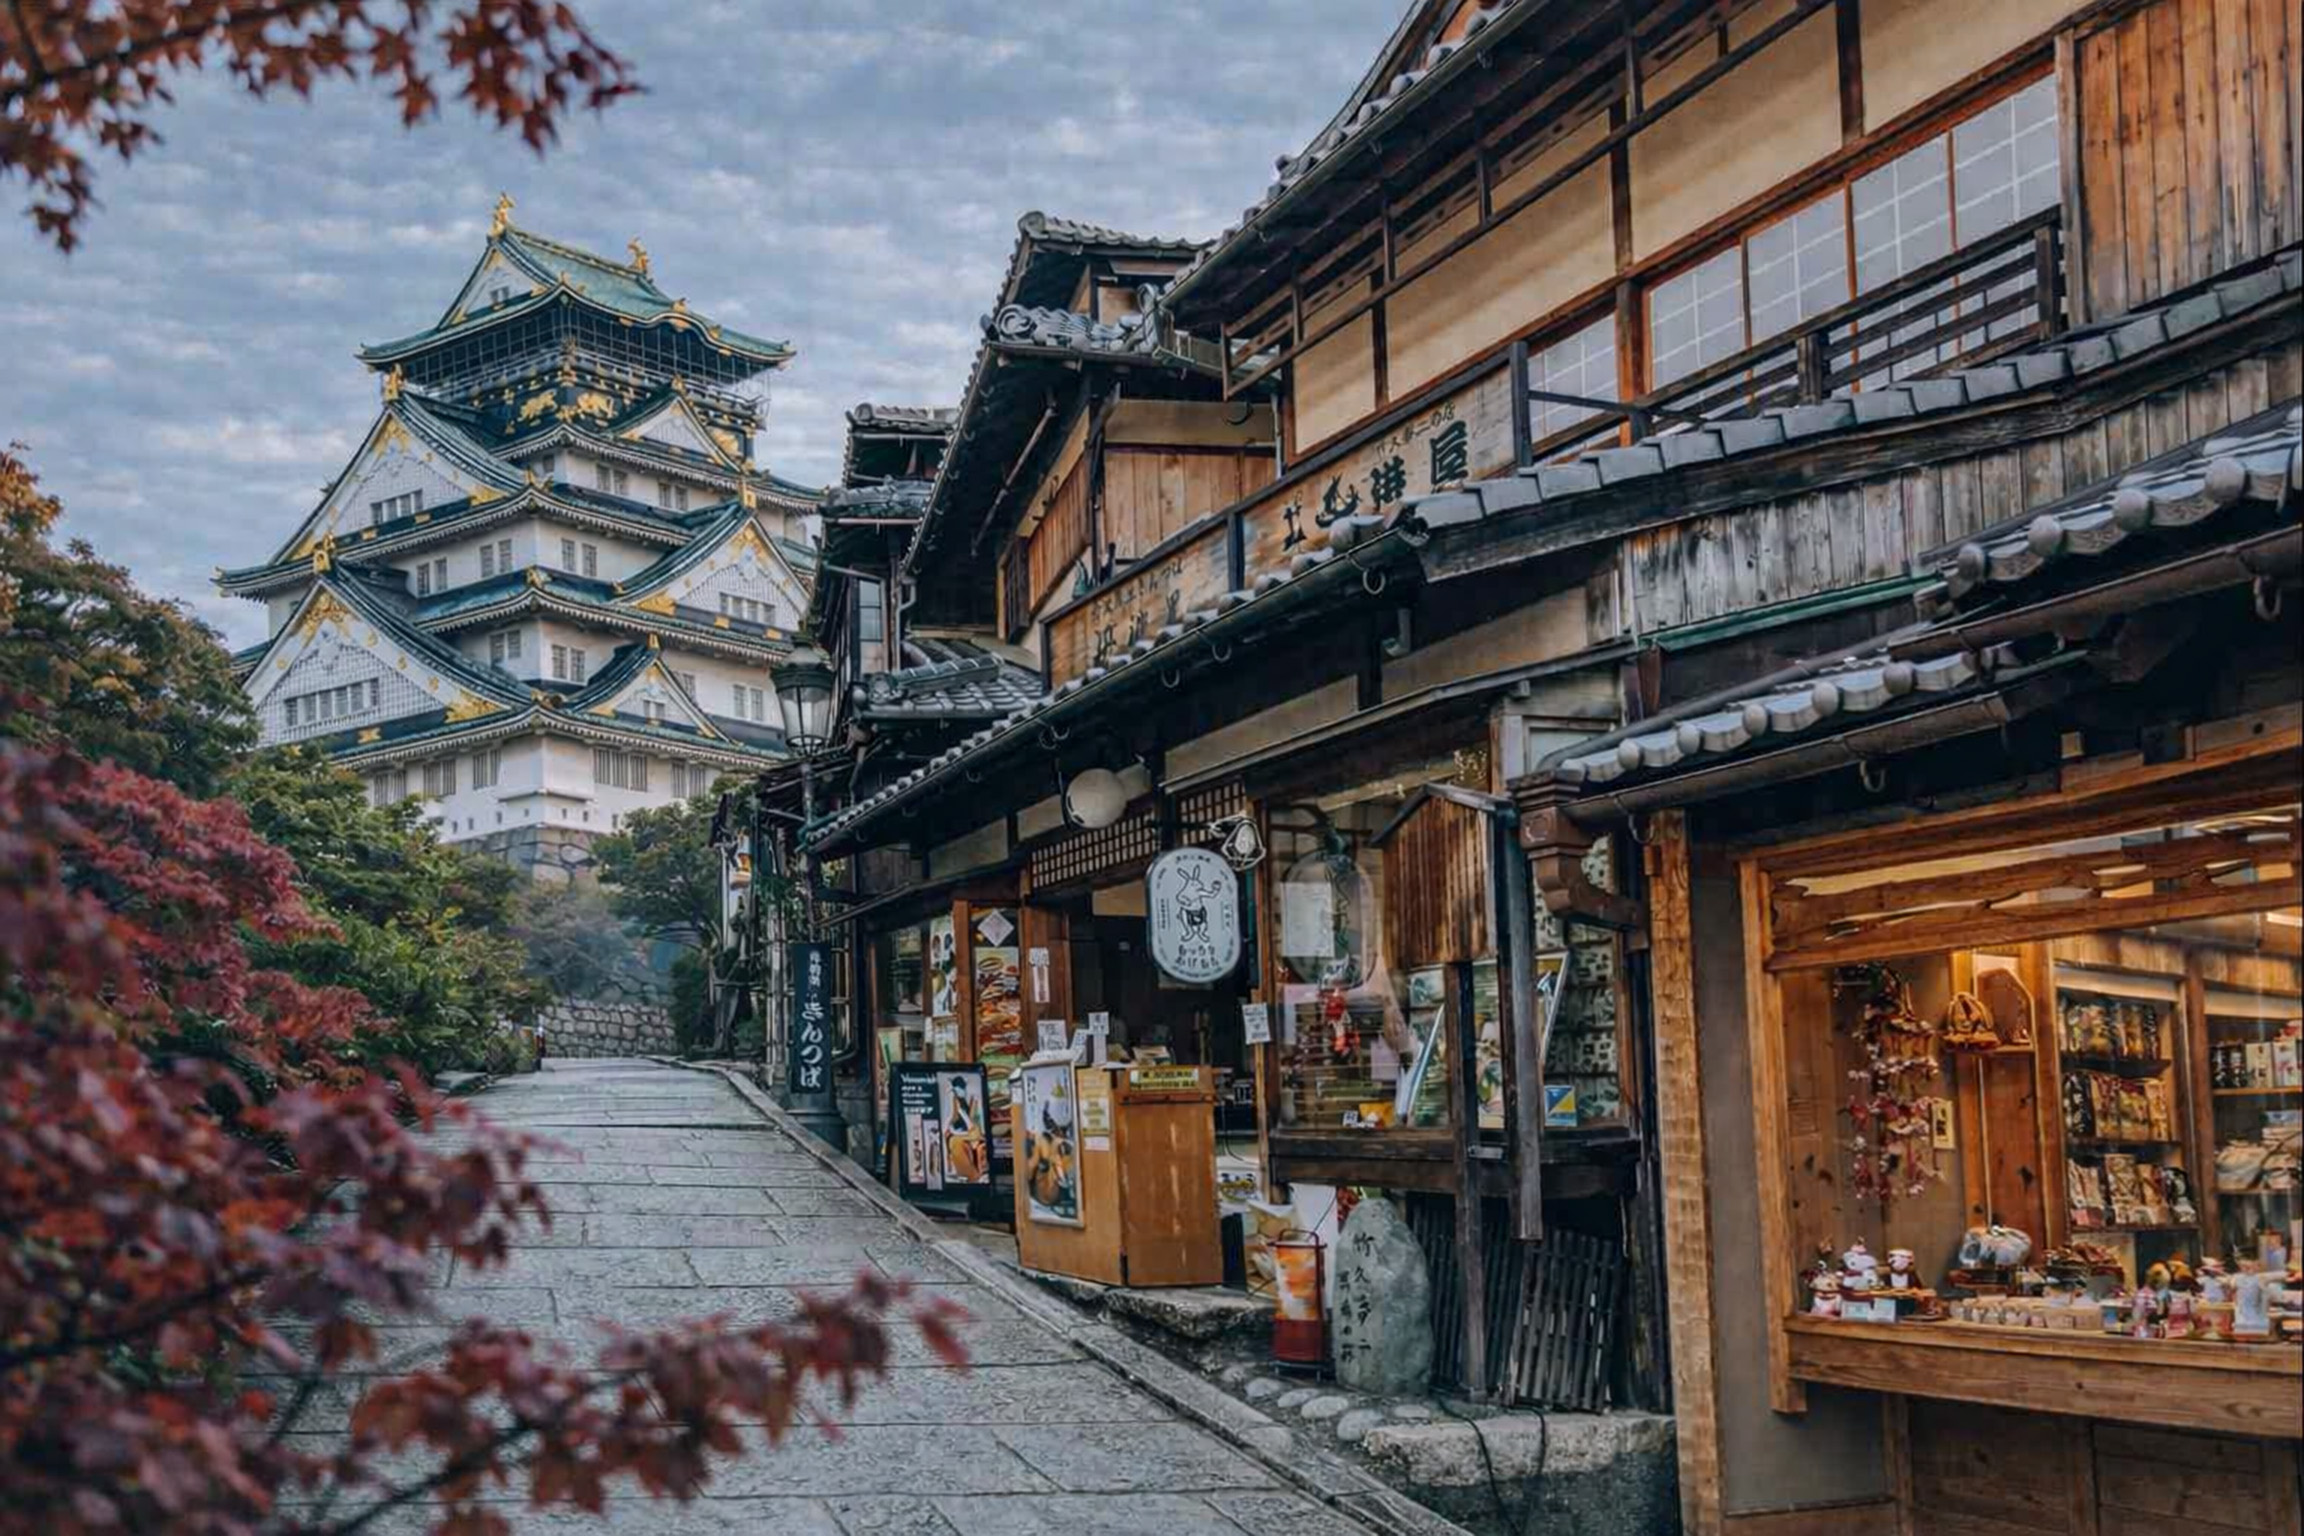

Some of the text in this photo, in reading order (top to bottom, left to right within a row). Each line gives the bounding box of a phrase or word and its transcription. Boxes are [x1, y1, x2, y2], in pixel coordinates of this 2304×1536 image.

[801, 1002, 824, 1088] きんつば
[1353, 1231, 1374, 1351] 竹久夢二
